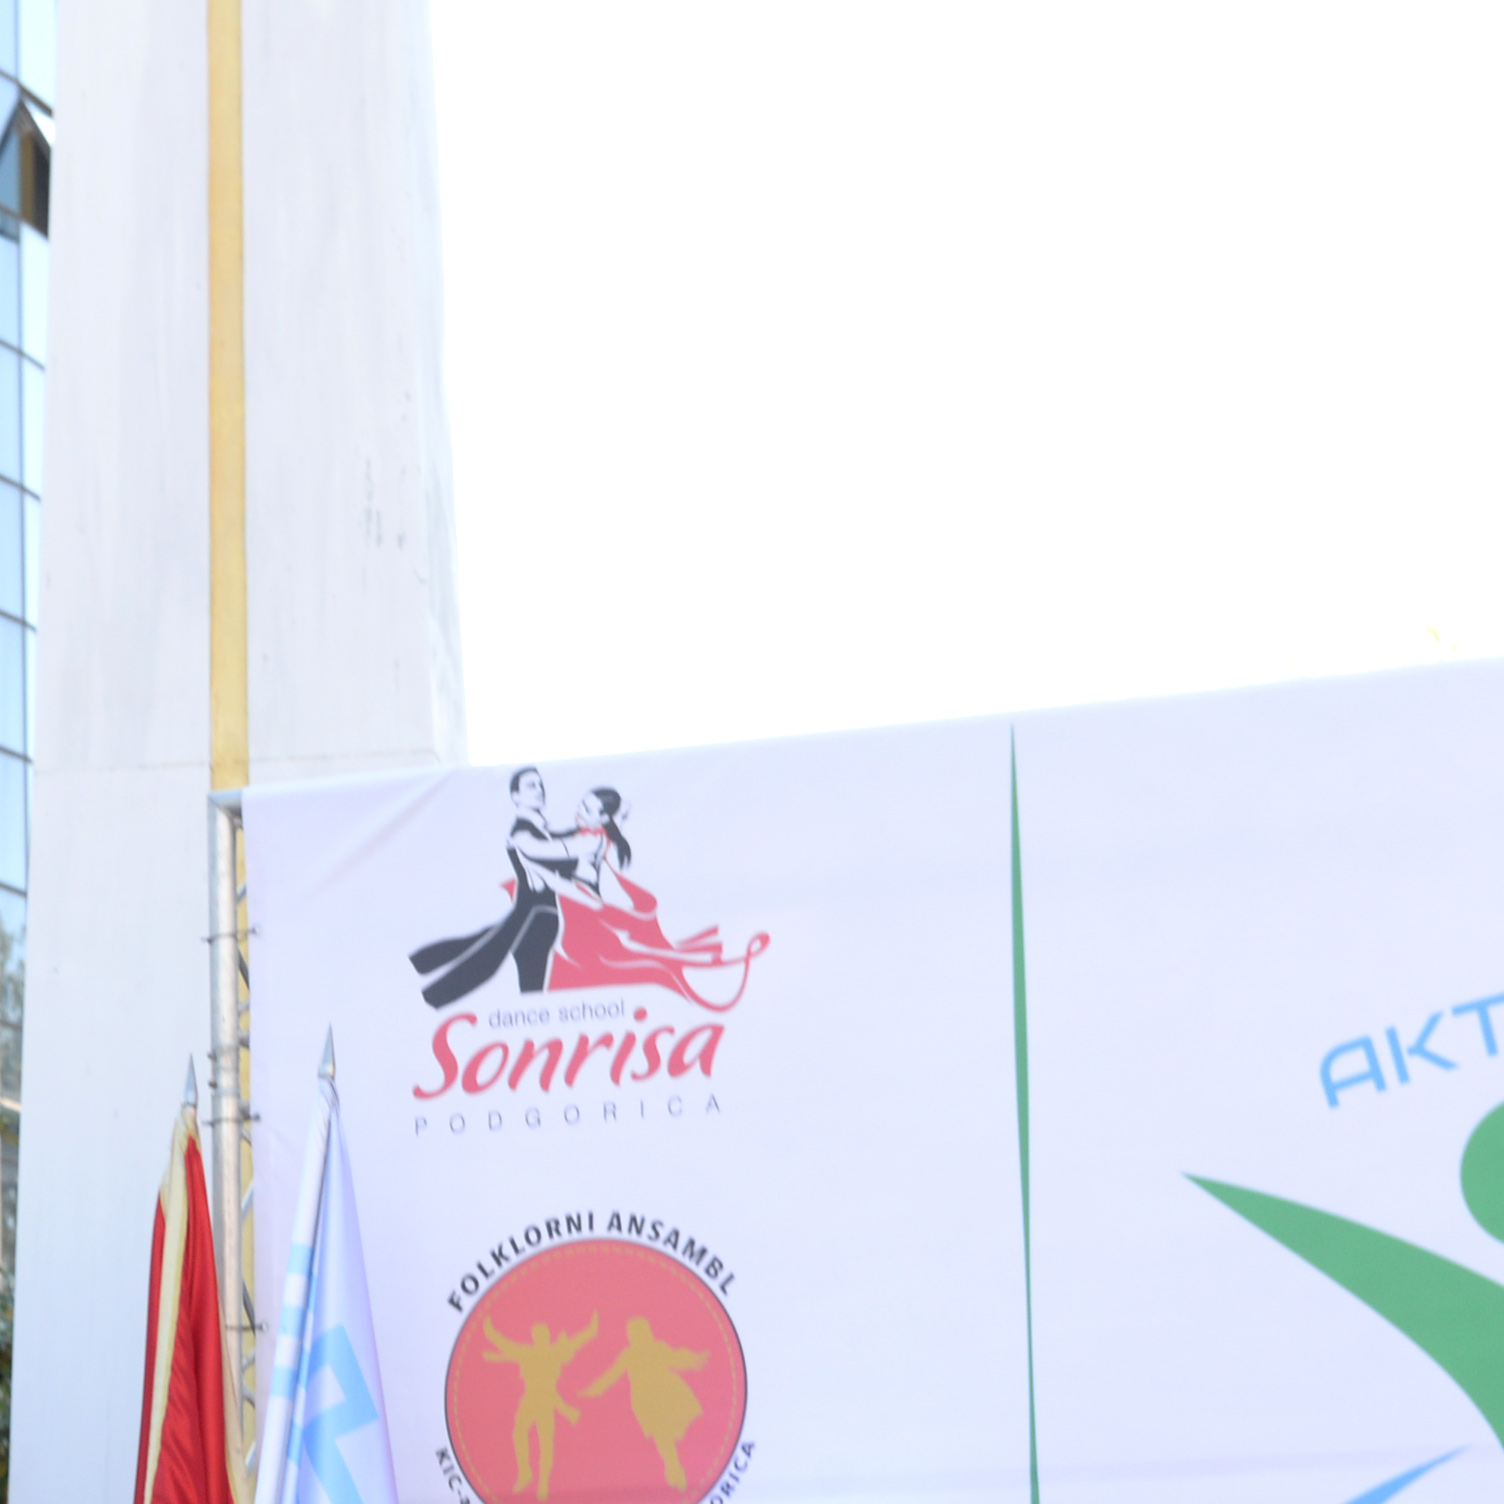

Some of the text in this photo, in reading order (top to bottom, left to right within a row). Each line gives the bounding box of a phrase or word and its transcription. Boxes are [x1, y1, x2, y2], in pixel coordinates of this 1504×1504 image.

[488, 1000, 625, 1029] dance school
[412, 1006, 725, 1100] Sonrisa
[412, 1093, 723, 1137] PODGORICA
[447, 1211, 735, 1313] FOLKLORNI ANSAMBL
